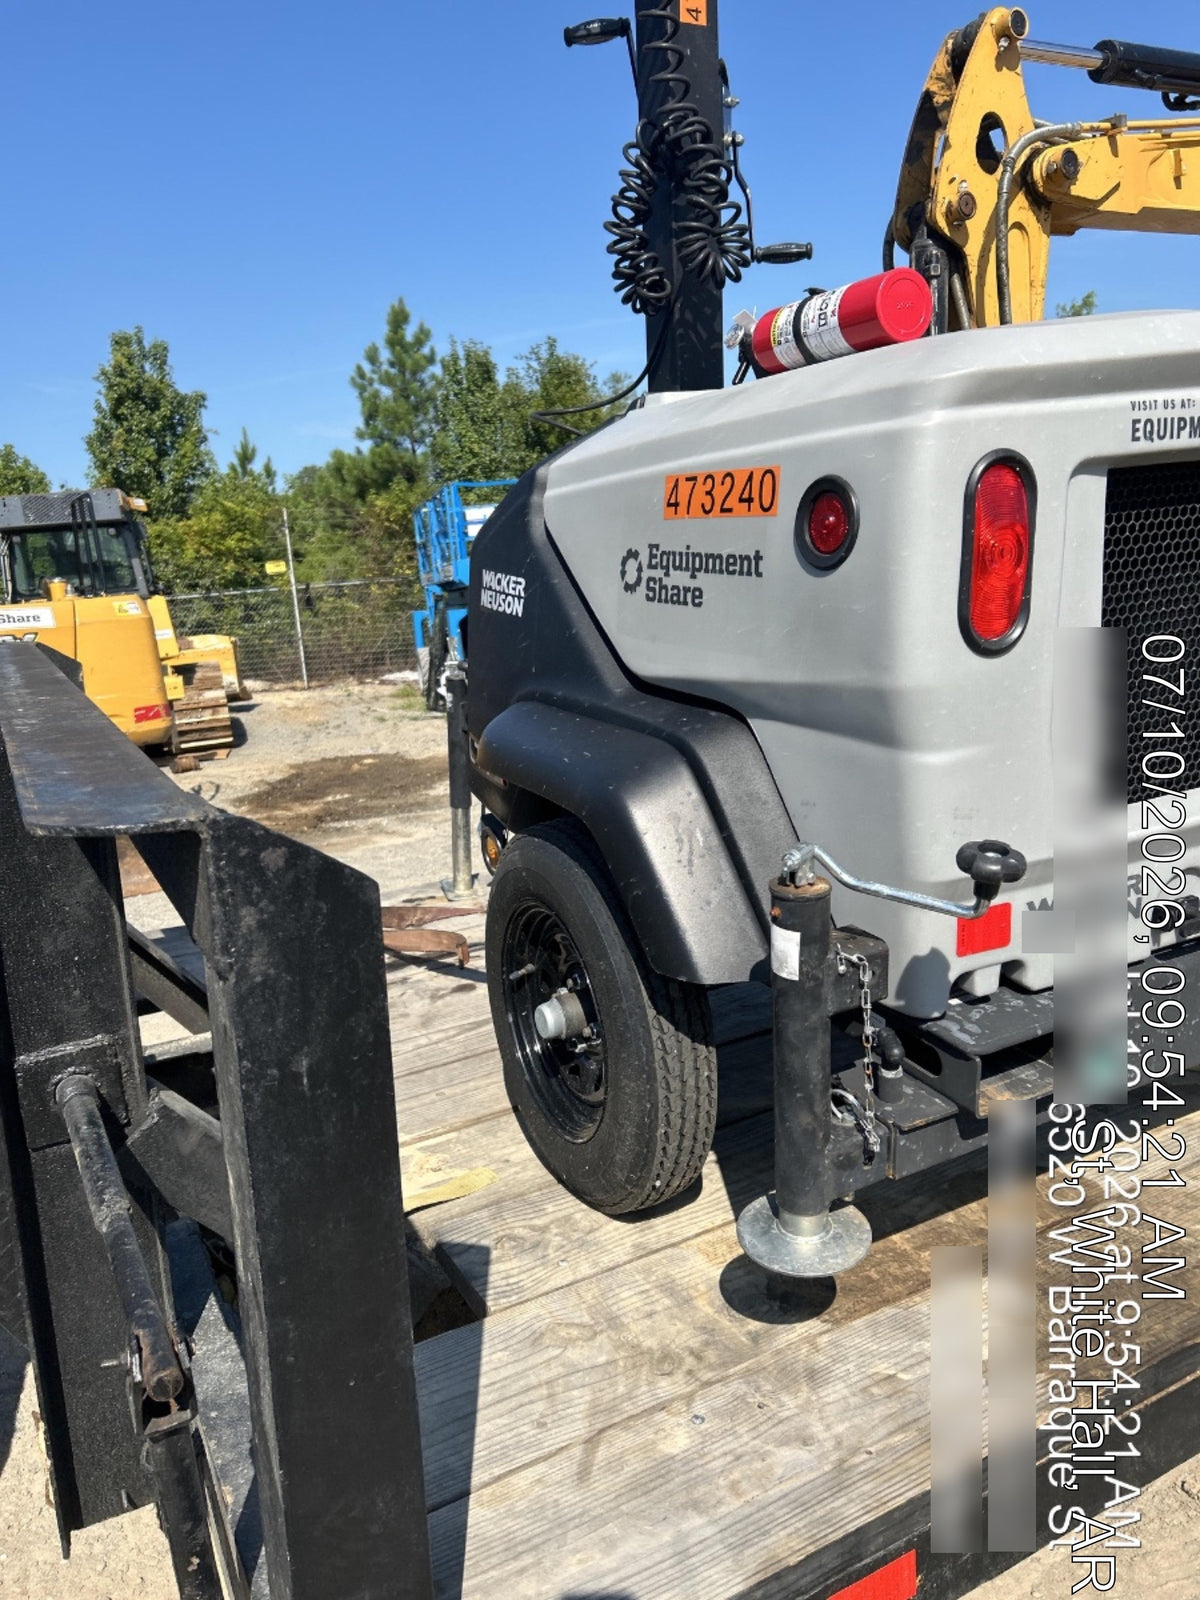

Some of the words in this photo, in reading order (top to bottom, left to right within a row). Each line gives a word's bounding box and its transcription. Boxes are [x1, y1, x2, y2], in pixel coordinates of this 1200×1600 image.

[1130, 400, 1158, 411] VISIT
[1163, 398, 1176, 410] US
[1181, 398, 1195, 409] AT:
[665, 469, 777, 516] 473240
[647, 543, 763, 578] Equipment
[482, 569, 526, 597] WACKER
[645, 576, 704, 608] Share
[480, 588, 525, 617] NEUSON
